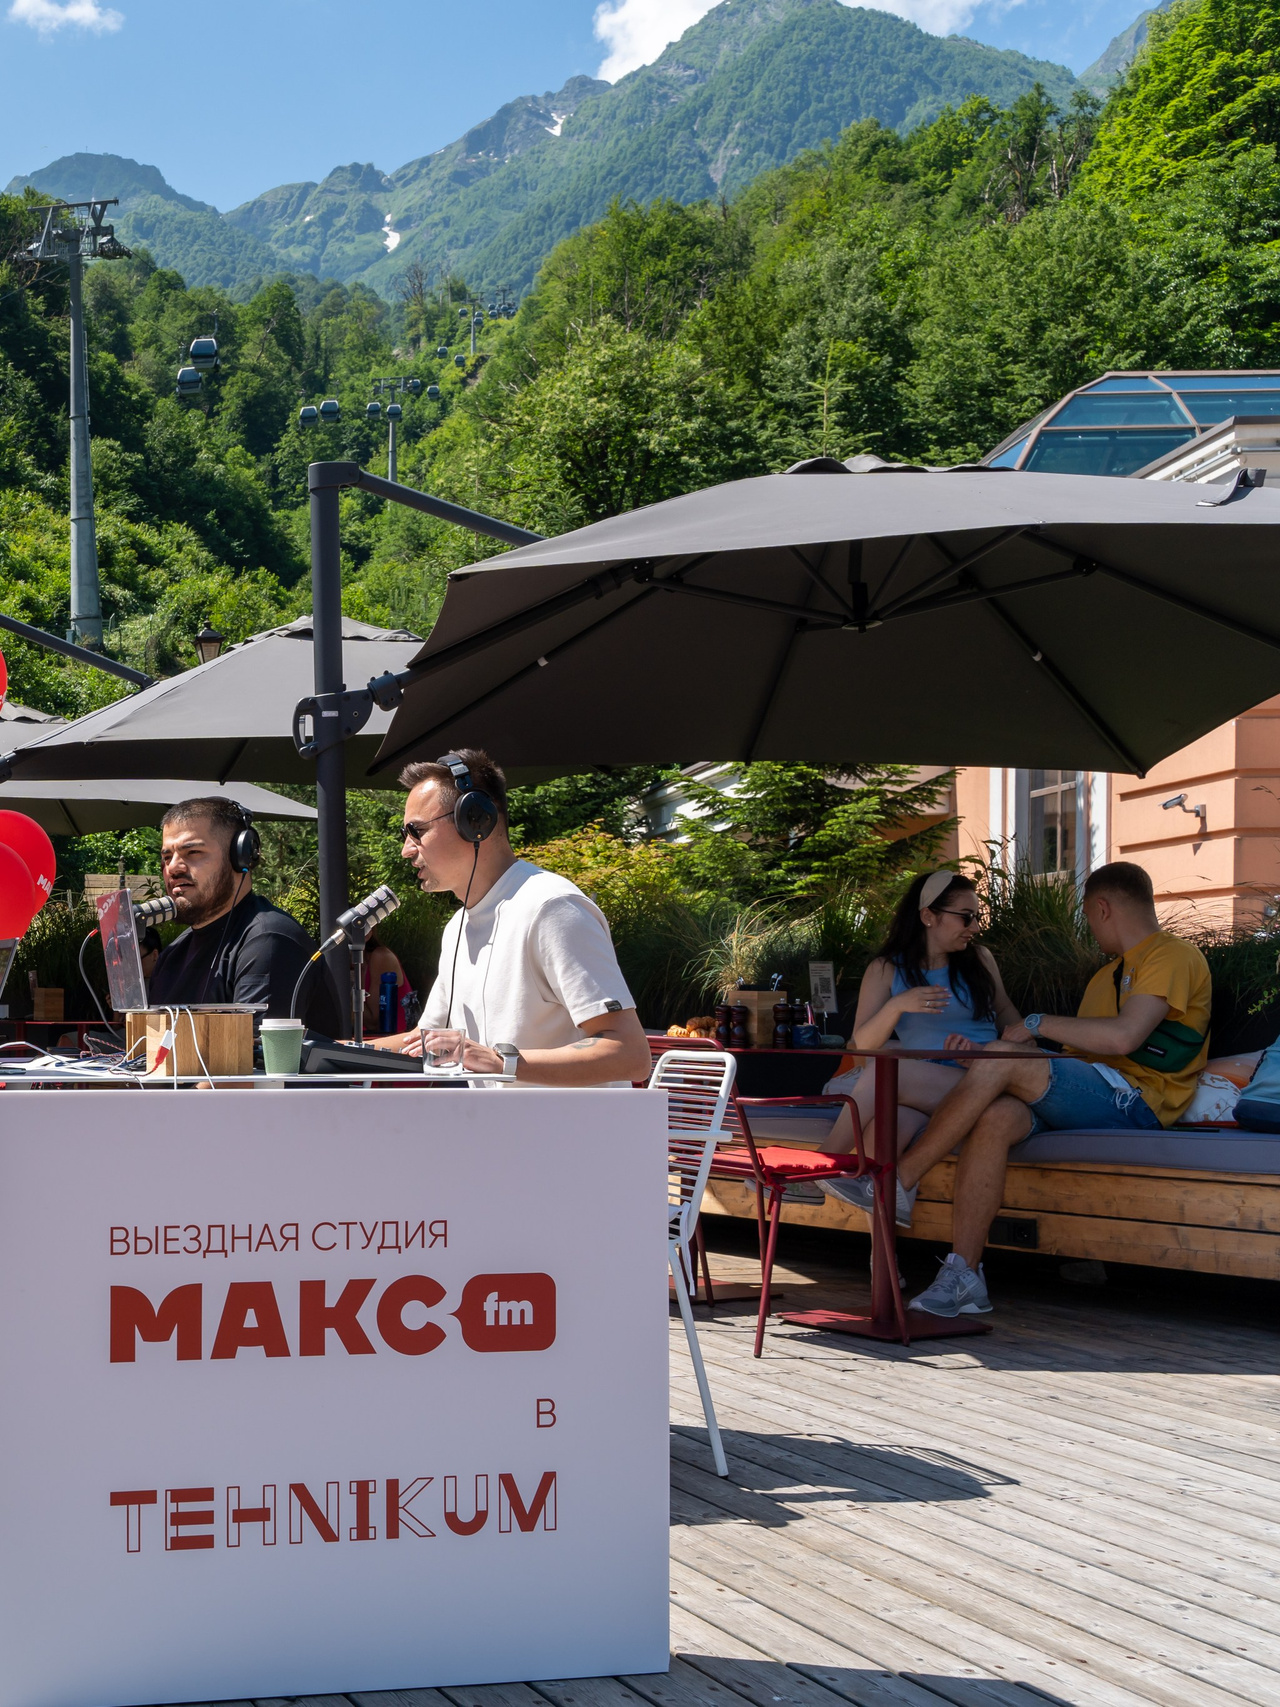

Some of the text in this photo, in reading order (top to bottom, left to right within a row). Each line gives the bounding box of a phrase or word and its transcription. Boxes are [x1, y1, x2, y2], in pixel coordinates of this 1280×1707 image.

[108, 1219, 449, 1259] ВЫЕЗДНАЯ СТУДИЯ
[109, 1274, 534, 1363] МАКС fm
[109, 1471, 558, 1553] TEHNIKUM
